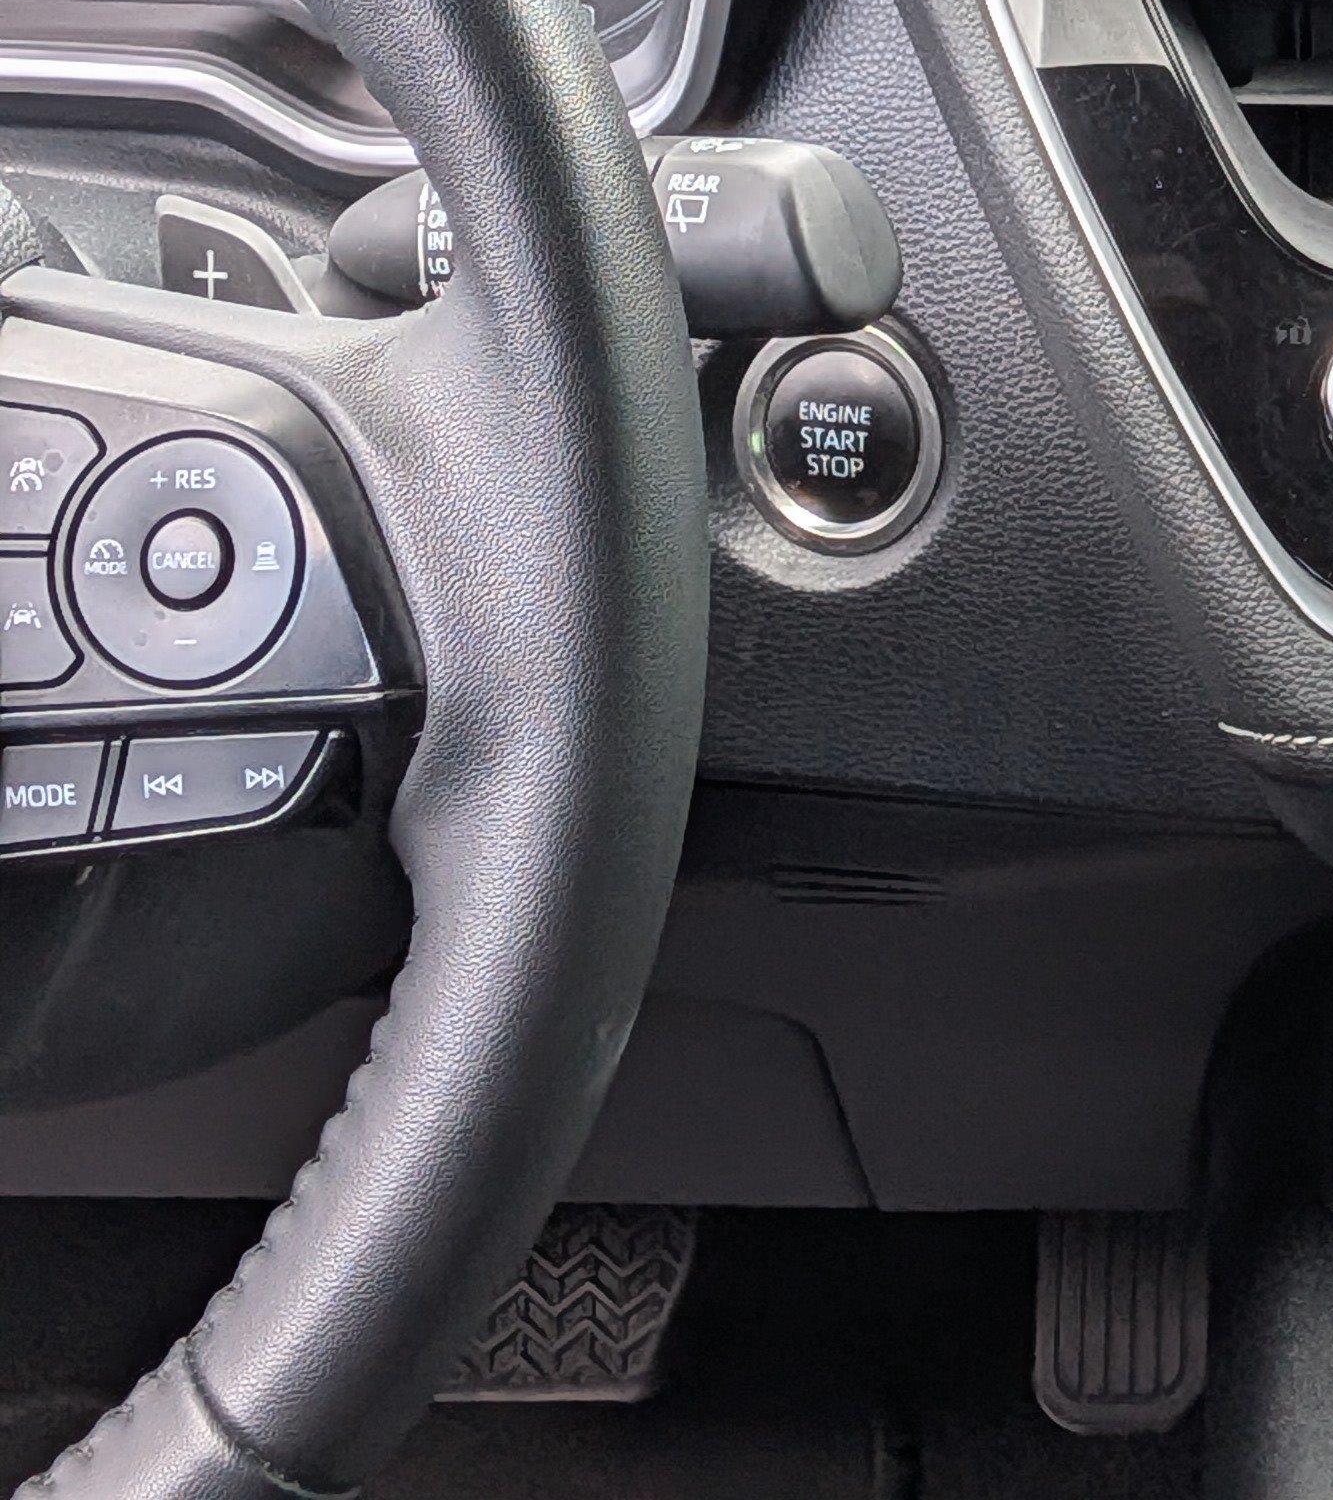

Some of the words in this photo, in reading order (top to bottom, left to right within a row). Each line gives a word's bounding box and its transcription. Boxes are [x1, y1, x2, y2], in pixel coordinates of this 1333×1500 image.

[667, 173, 721, 193] REAR
[799, 400, 873, 426] ENGINE
[800, 426, 869, 453] START
[806, 453, 865, 478] STOP
[175, 468, 216, 489] RES
[84, 561, 128, 575] MODE
[151, 551, 217, 570] CANCEL
[5, 783, 77, 809] MODE
